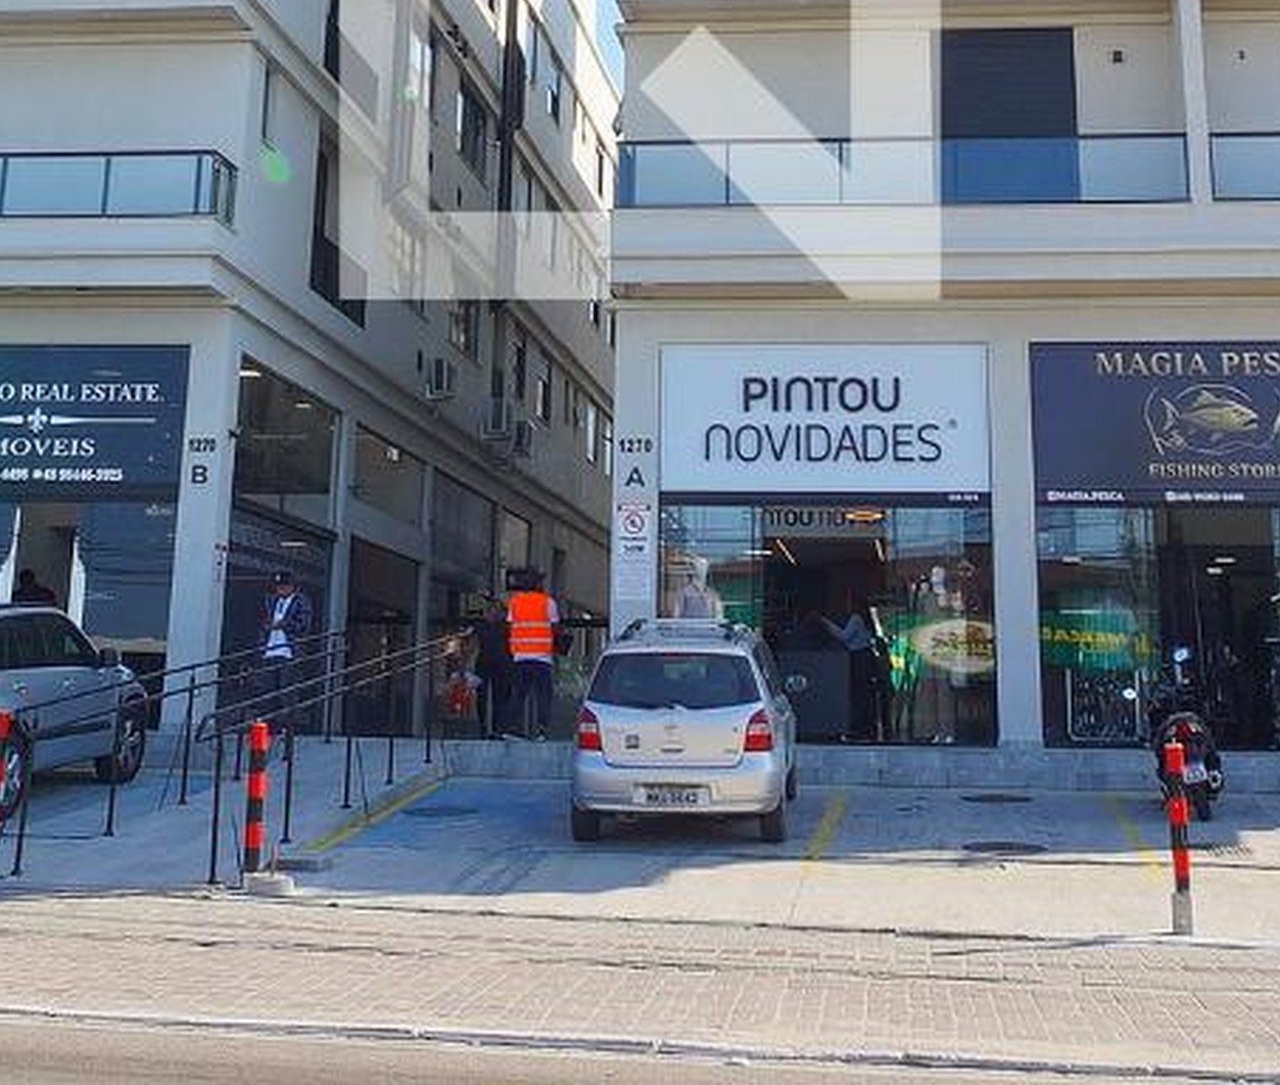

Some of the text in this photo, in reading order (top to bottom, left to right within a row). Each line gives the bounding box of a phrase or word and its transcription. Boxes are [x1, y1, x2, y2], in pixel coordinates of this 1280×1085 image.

[1096, 352, 1208, 375] MAGIA
[21, 382, 75, 401] REAL
[742, 376, 900, 413] PINTOU
[189, 438, 216, 453] 1270
[619, 439, 652, 453] 1270
[704, 423, 943, 462] NOVIDADES
[192, 467, 208, 484] B
[625, 466, 645, 487] A
[1149, 464, 1224, 479] FISHING
